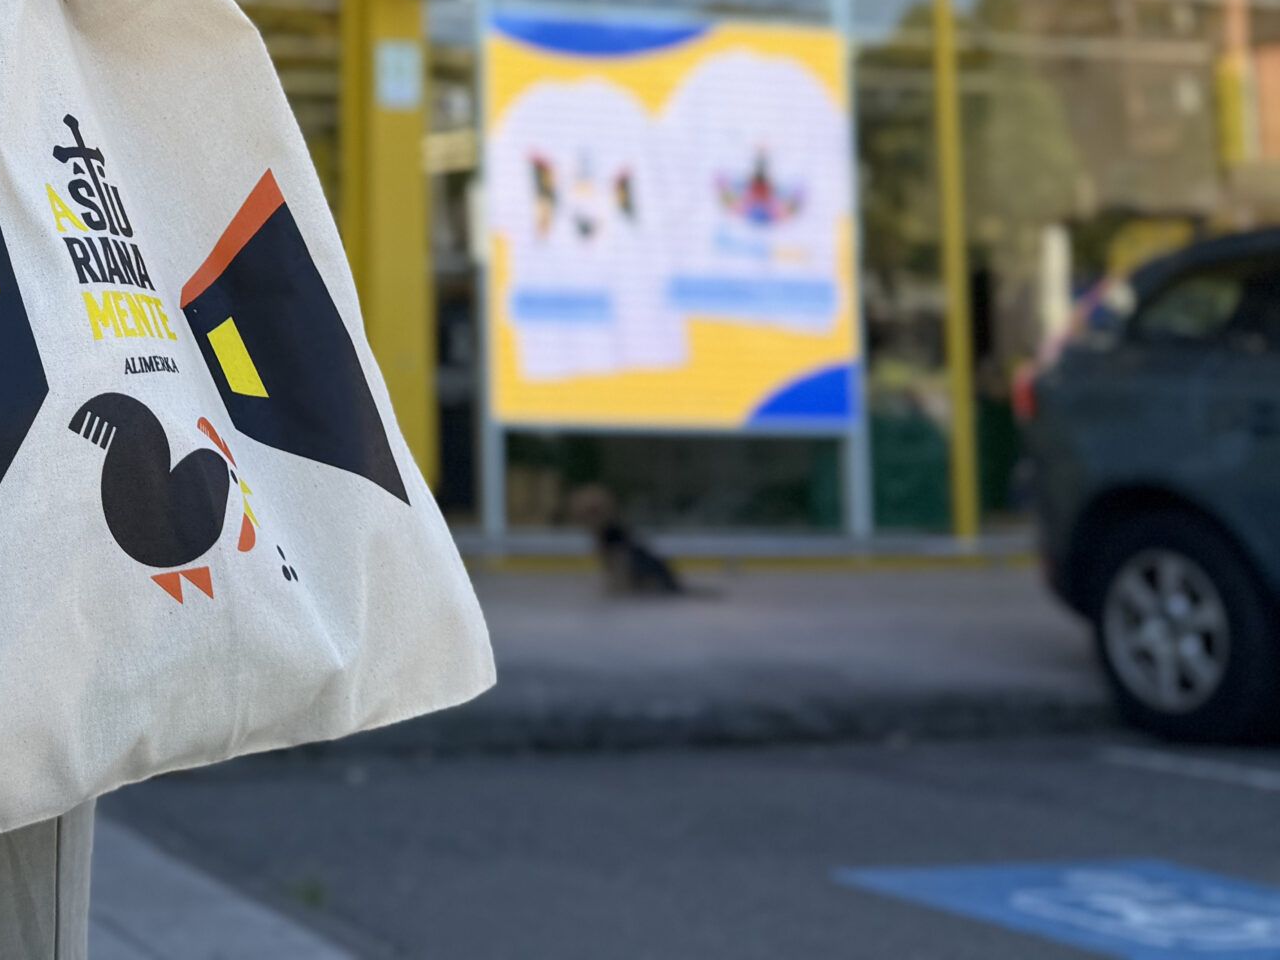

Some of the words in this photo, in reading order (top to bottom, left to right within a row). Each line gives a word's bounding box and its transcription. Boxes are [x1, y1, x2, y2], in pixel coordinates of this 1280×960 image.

[62, 236, 156, 291] RIANA
[81, 290, 177, 341] MENTE
[124, 355, 180, 375] ALIMERKA
